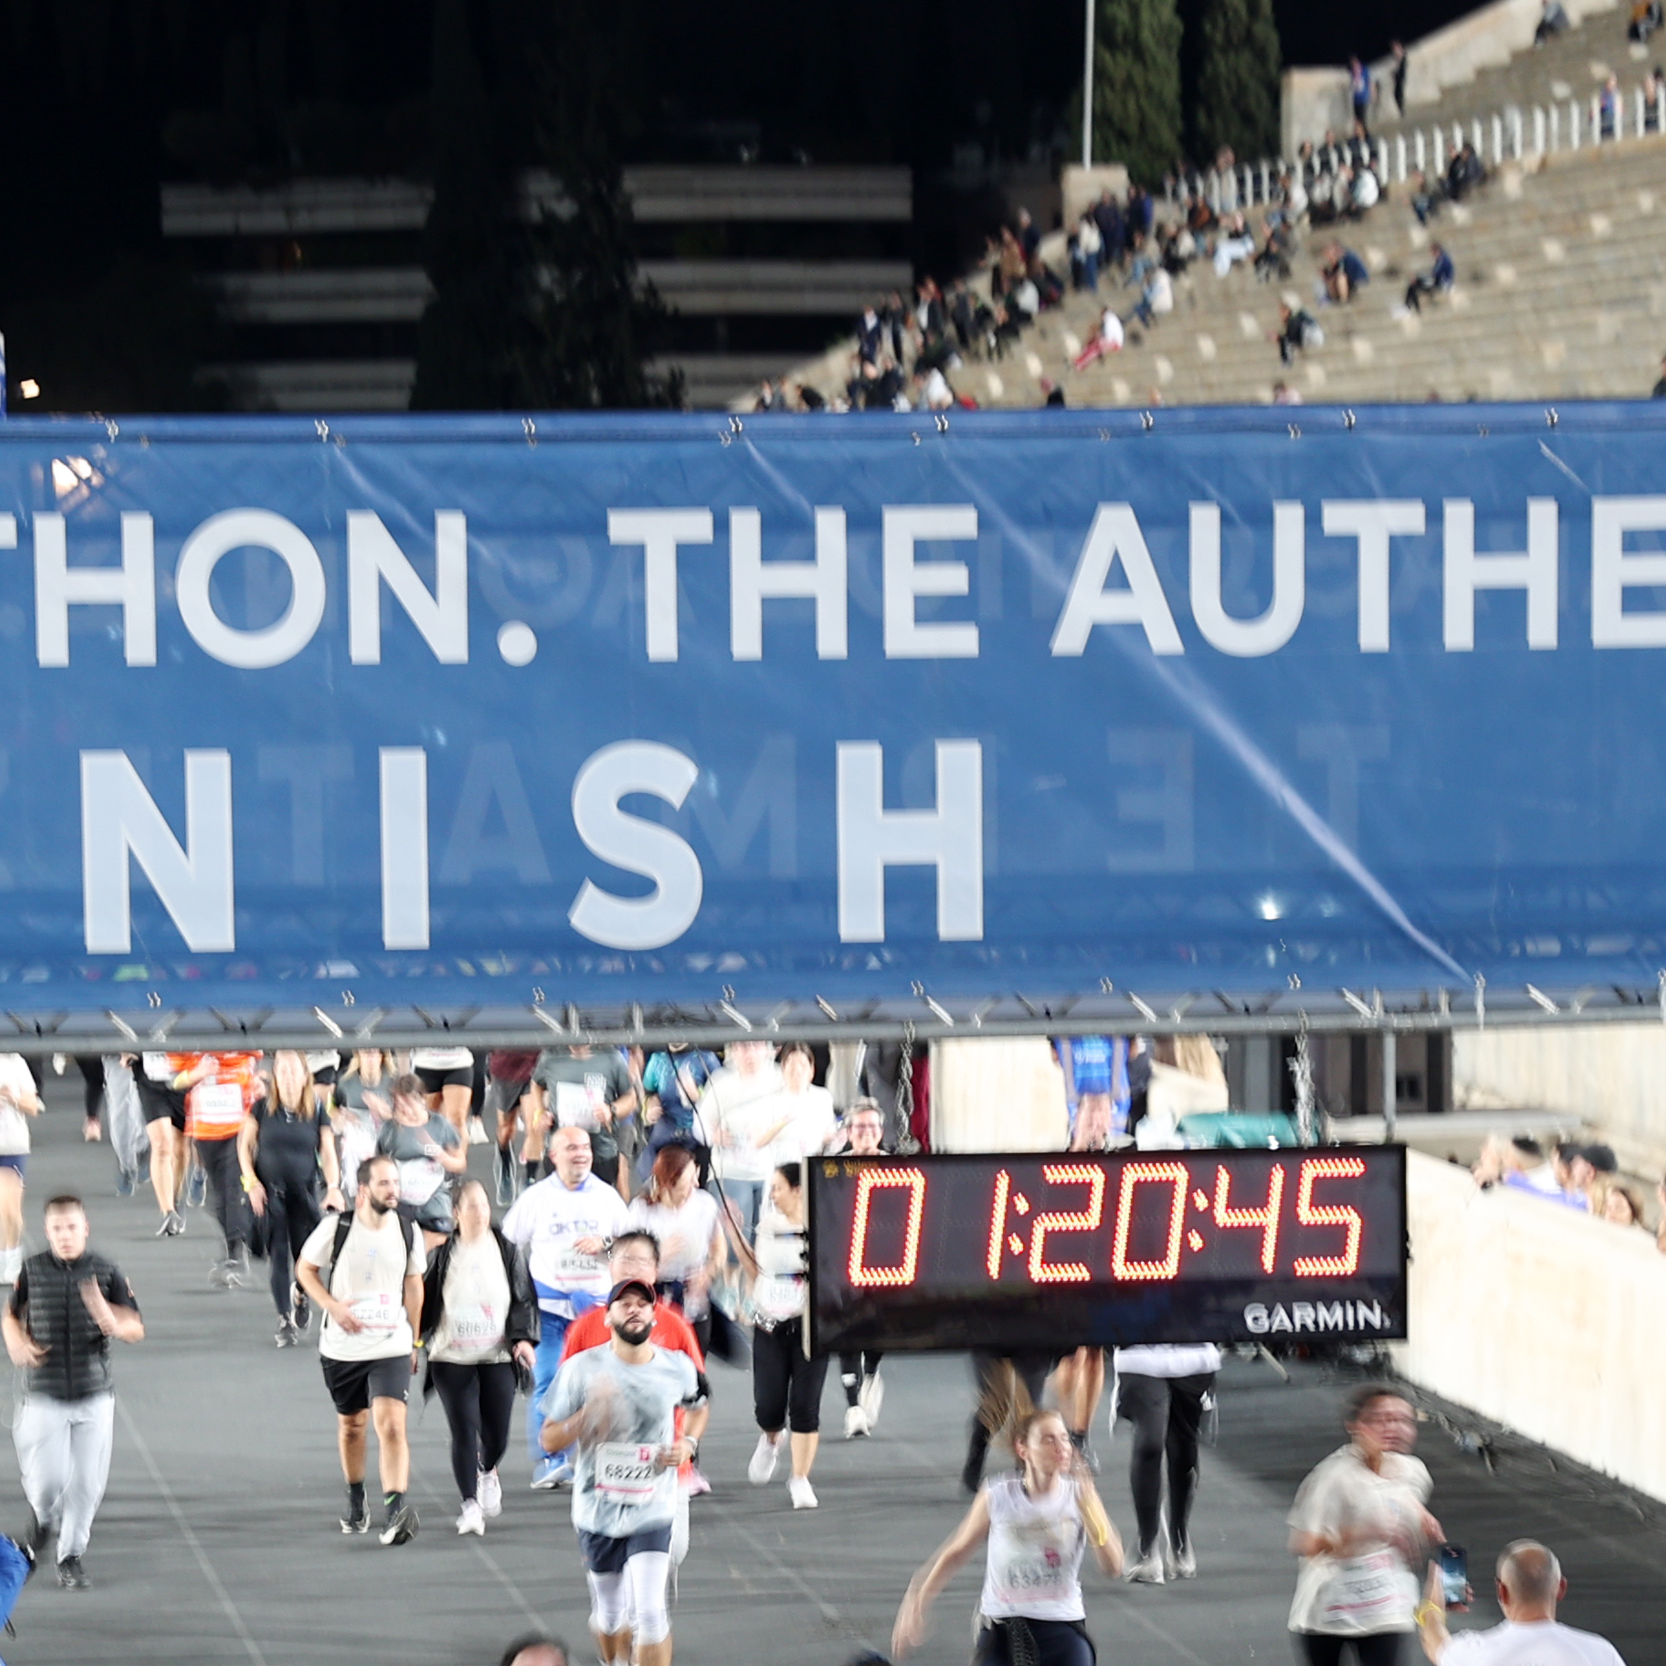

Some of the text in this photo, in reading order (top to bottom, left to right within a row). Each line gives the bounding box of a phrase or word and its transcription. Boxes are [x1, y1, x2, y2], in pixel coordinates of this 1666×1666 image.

[609, 500, 981, 663] THE
[1244, 1299, 1383, 1335] GARMIN
[604, 1463, 653, 1480] 68222
